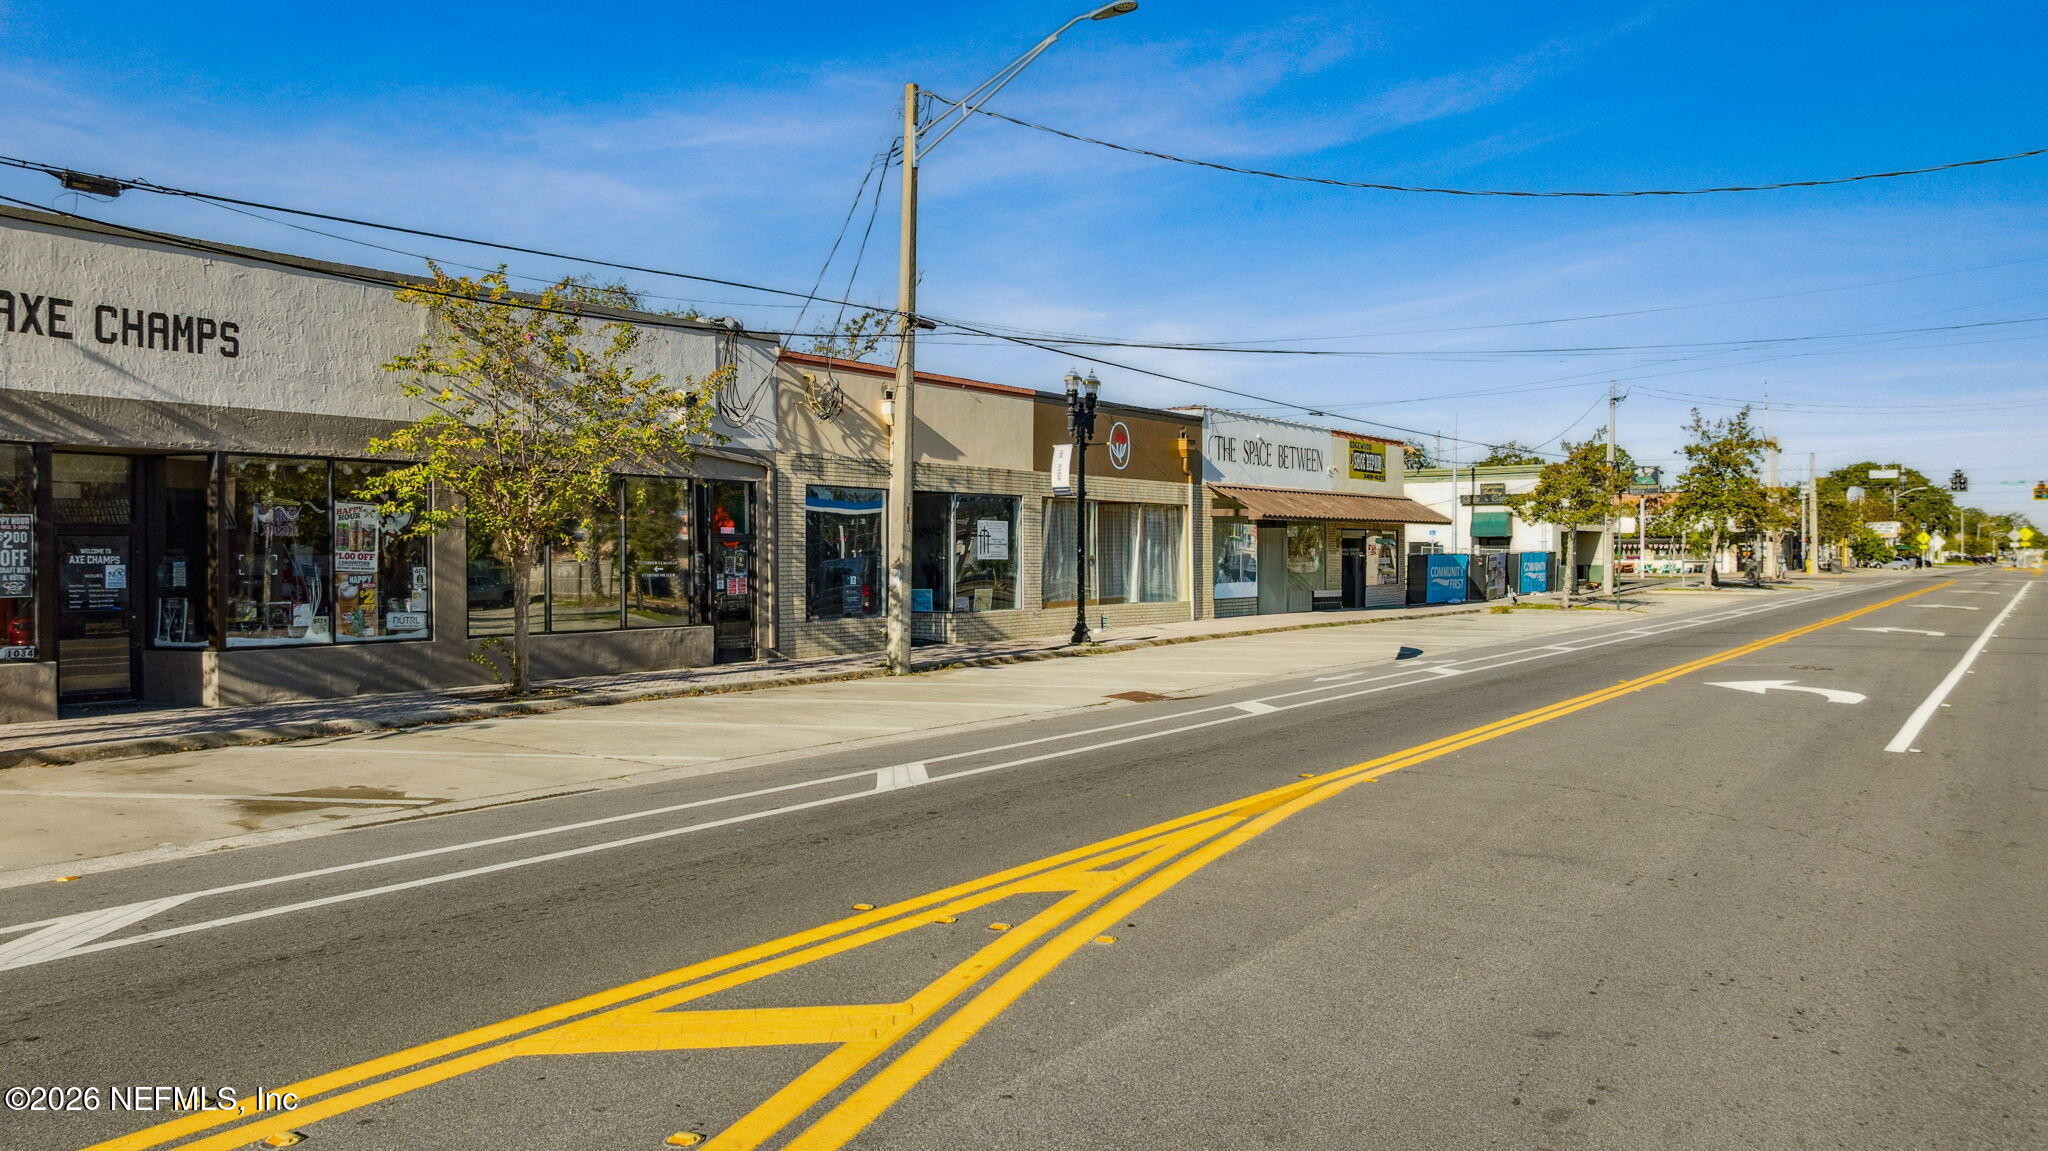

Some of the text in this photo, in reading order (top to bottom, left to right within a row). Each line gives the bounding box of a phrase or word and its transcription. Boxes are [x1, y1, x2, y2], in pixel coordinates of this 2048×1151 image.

[0, 290, 240, 358] AXE CHAMPS
[1214, 435, 1323, 473] THE SPACE BETWEEN
[336, 505, 364, 515] HAPPY
[12, 517, 30, 525] HOUR
[338, 513, 361, 521] HOUR
[0, 549, 28, 567] OFF
[69, 555, 120, 565] AXE CHAMPS
[357, 553, 376, 561] OFF
[1430, 566, 1464, 577] COMMUNITY
[349, 575, 373, 584] HAPPY
[1449, 579, 1464, 589] FIRST
[360, 589, 374, 604] $2
[7, 649, 34, 658] 1034
